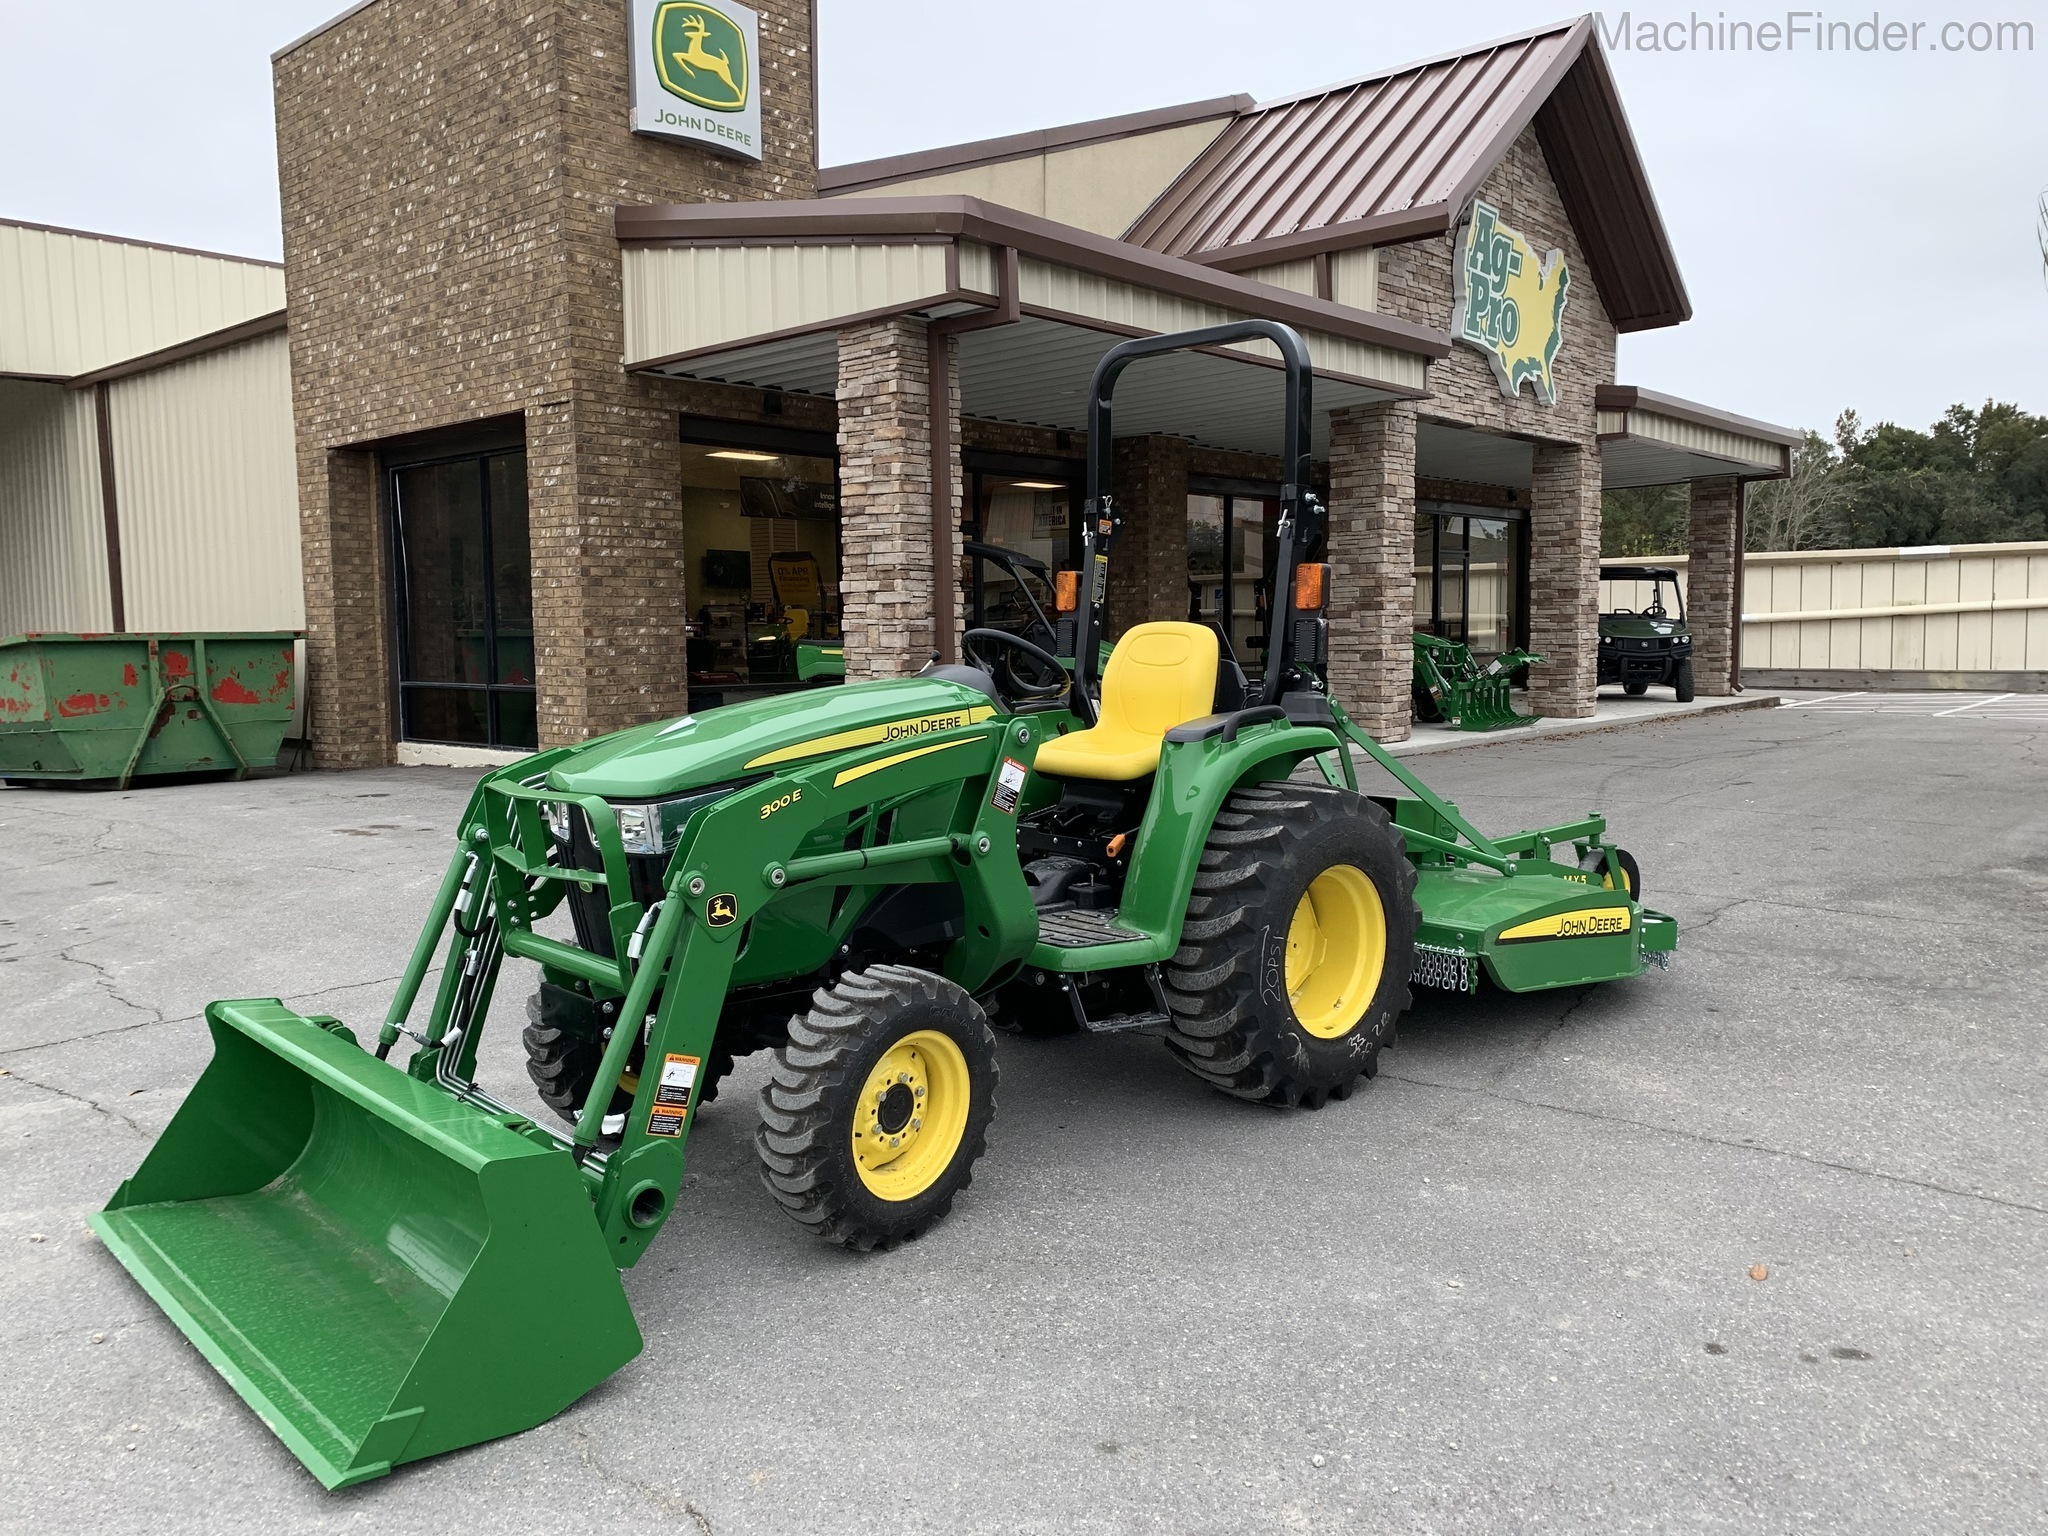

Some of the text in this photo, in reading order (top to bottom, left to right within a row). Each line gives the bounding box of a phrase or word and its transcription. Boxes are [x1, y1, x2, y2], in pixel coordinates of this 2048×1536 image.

[654, 109, 752, 147] JOHN DEERE
[1467, 205, 1523, 296] Ag-
[1464, 273, 1519, 348] Pro
[882, 716, 961, 742] JOHN DEERE
[760, 788, 802, 820] 300 E
[1556, 916, 1623, 936] JOHN DEERE
